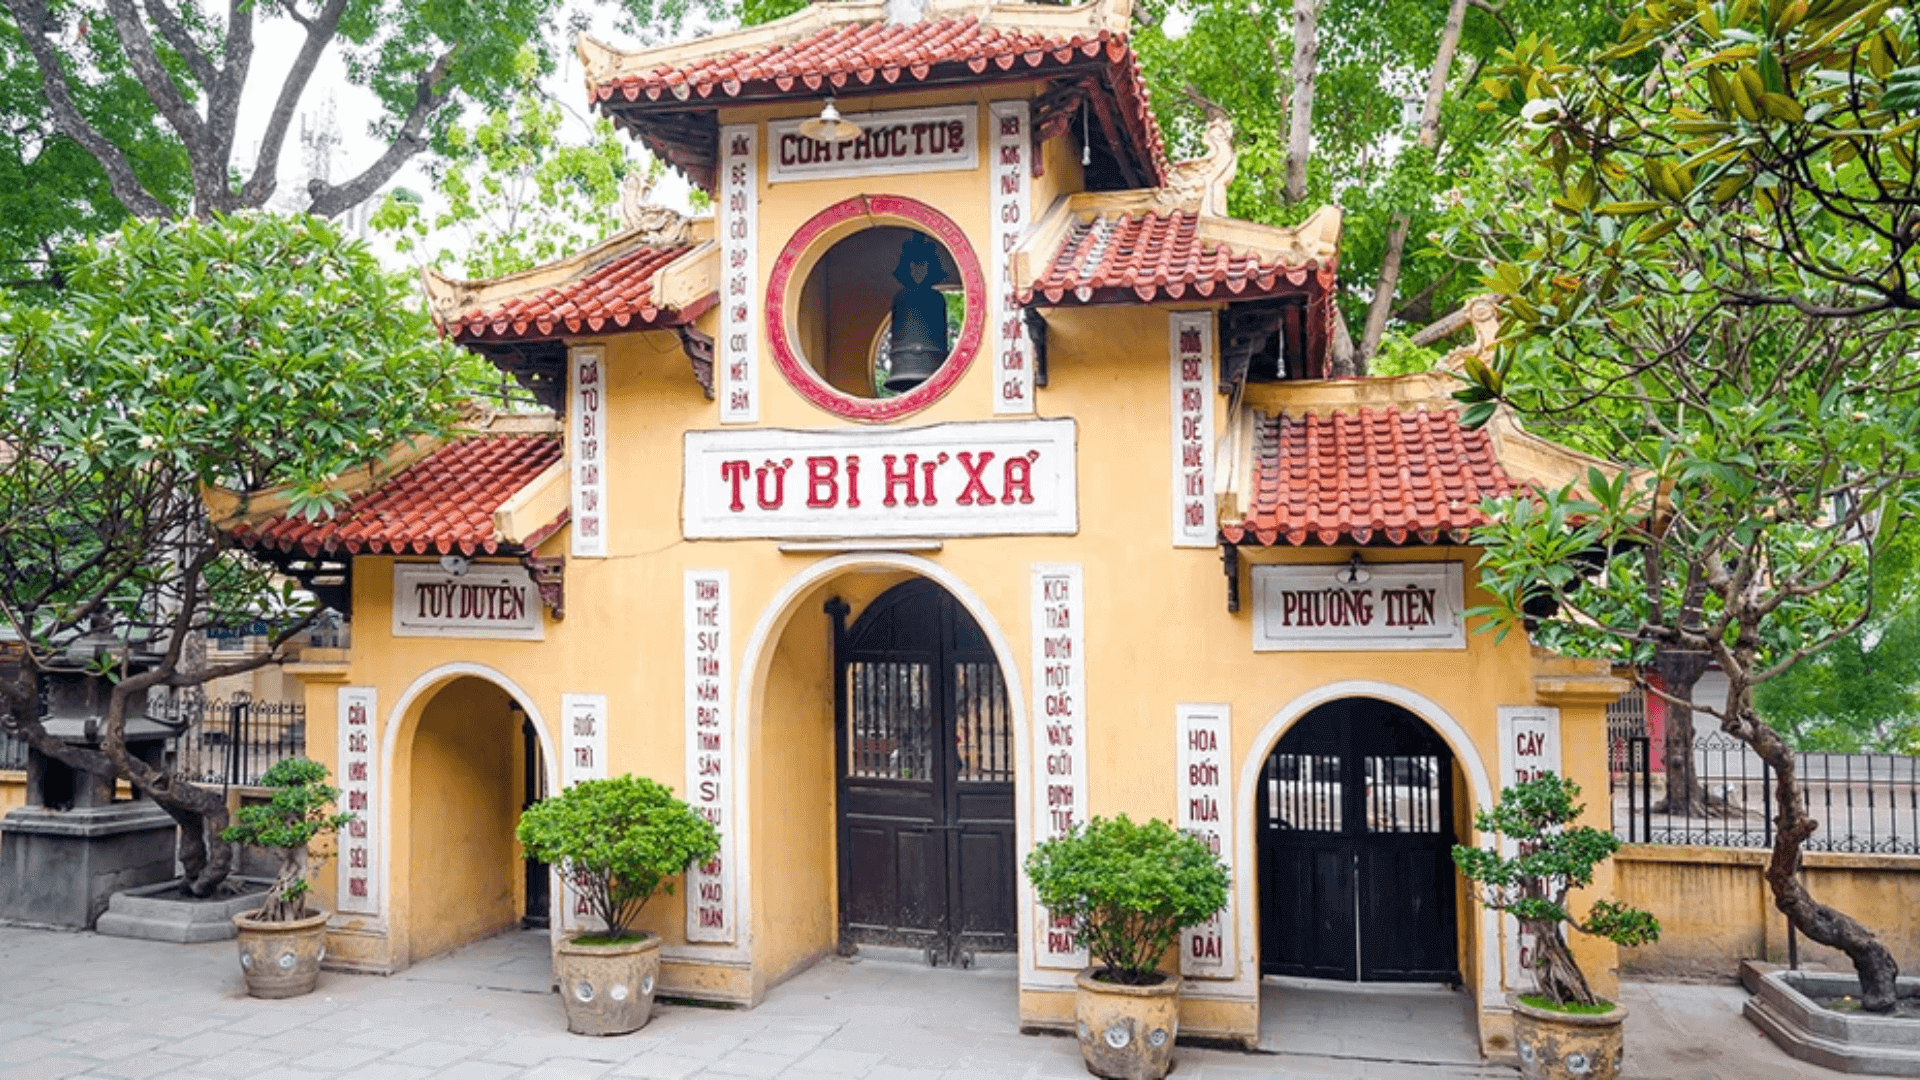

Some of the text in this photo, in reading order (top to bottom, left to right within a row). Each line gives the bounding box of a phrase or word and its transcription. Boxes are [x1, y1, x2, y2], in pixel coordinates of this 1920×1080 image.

[458, 579, 526, 620] DUYÊN
[1381, 584, 1436, 631] TIỆN
[1188, 729, 1218, 752] HOA
[1515, 729, 1546, 757] CÂY
[1188, 758, 1219, 787] BỐN
[699, 781, 720, 802] SI
